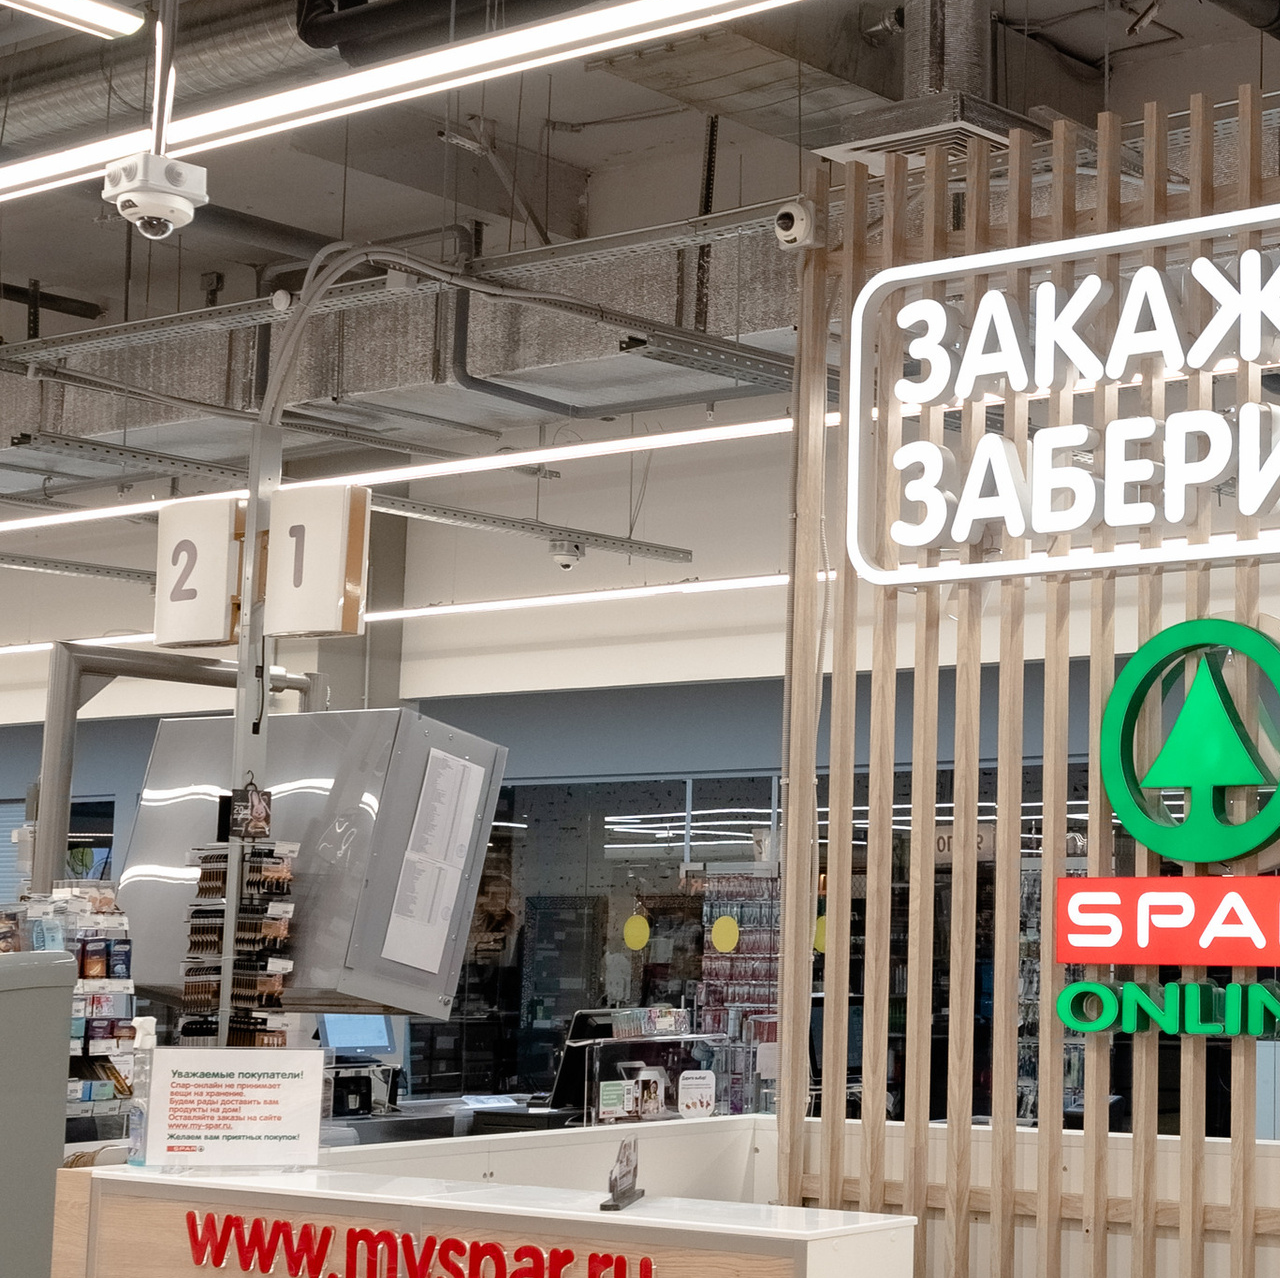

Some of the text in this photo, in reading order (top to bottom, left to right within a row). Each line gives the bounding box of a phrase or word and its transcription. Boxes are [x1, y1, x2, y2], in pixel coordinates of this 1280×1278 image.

[288, 524, 305, 589] 1
[170, 539, 198, 601] 2
[171, 1069, 304, 1082] Уважаемые покупатели!
[170, 1081, 223, 1090] Спар-онлайн
[237, 1083, 282, 1091] принимает
[169, 1097, 195, 1105] Будем
[169, 1107, 208, 1115] продукты
[222, 1106, 242, 1114] дом!
[168, 1114, 215, 1122] Оставляйте
[167, 1133, 201, 1141] Желаем
[222, 1134, 262, 1142] приятных
[264, 1133, 300, 1142] покупок!
